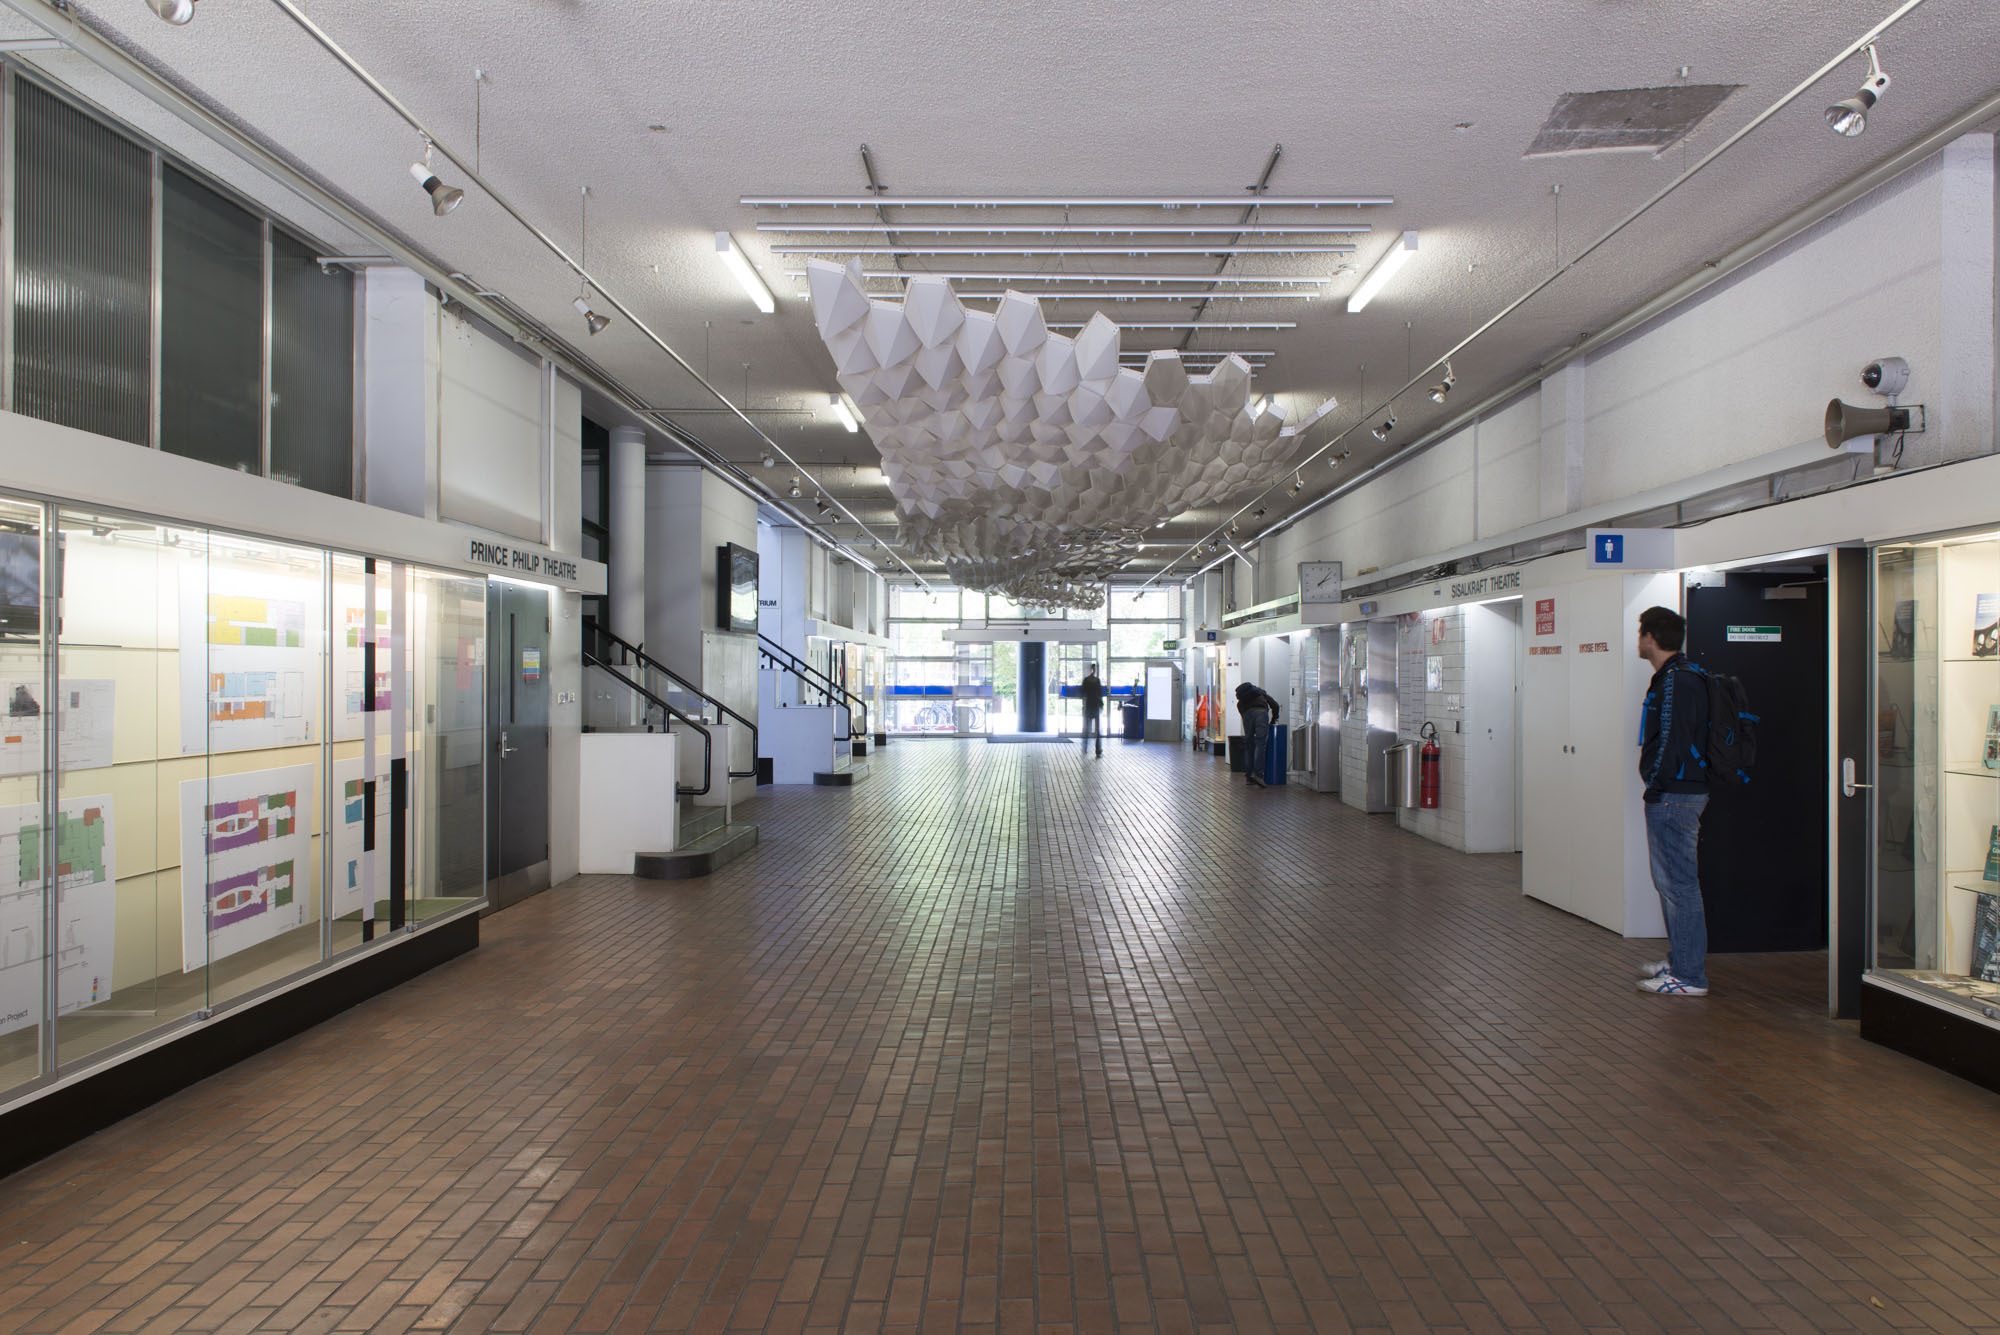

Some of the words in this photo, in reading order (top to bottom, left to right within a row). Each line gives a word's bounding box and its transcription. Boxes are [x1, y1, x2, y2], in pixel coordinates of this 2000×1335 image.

[470, 540, 508, 566] PRINCE
[512, 550, 540, 572] PHILIP
[543, 557, 577, 580] THEATRE
[1451, 578, 1487, 598] SISALKRAFT
[1490, 572, 1520, 592] THEATRE
[1540, 602, 1550, 612] FIRE
[1536, 612, 1555, 622] HYDRANT
[1541, 622, 1553, 633] HOSE
[7, 1009, 28, 1022] Project
